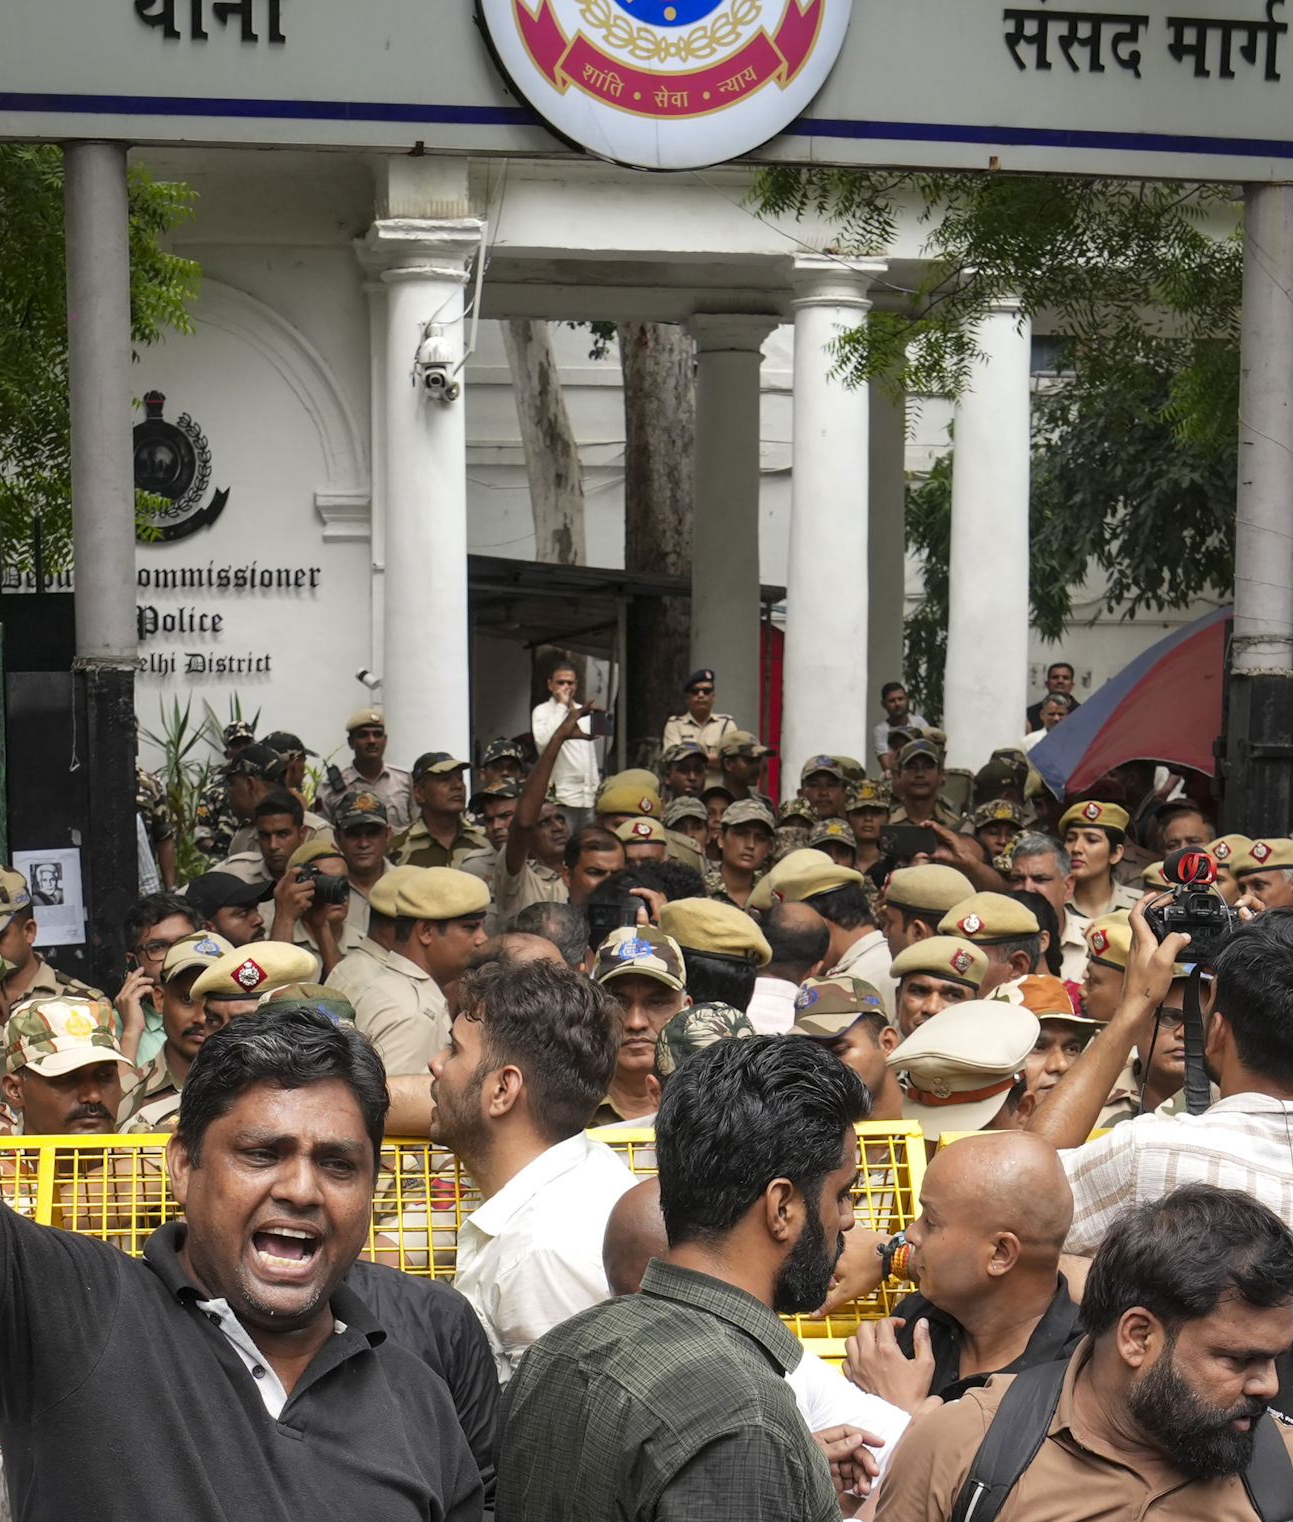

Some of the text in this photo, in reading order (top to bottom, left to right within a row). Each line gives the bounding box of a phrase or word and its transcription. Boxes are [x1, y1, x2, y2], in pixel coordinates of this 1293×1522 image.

[1165, 0, 1288, 82] मार्ग
[581, 62, 758, 108] शांति सेवा न्याय
[137, 560, 322, 590] ommissioner
[136, 605, 224, 641] Police
[139, 652, 272, 677] elhi District
